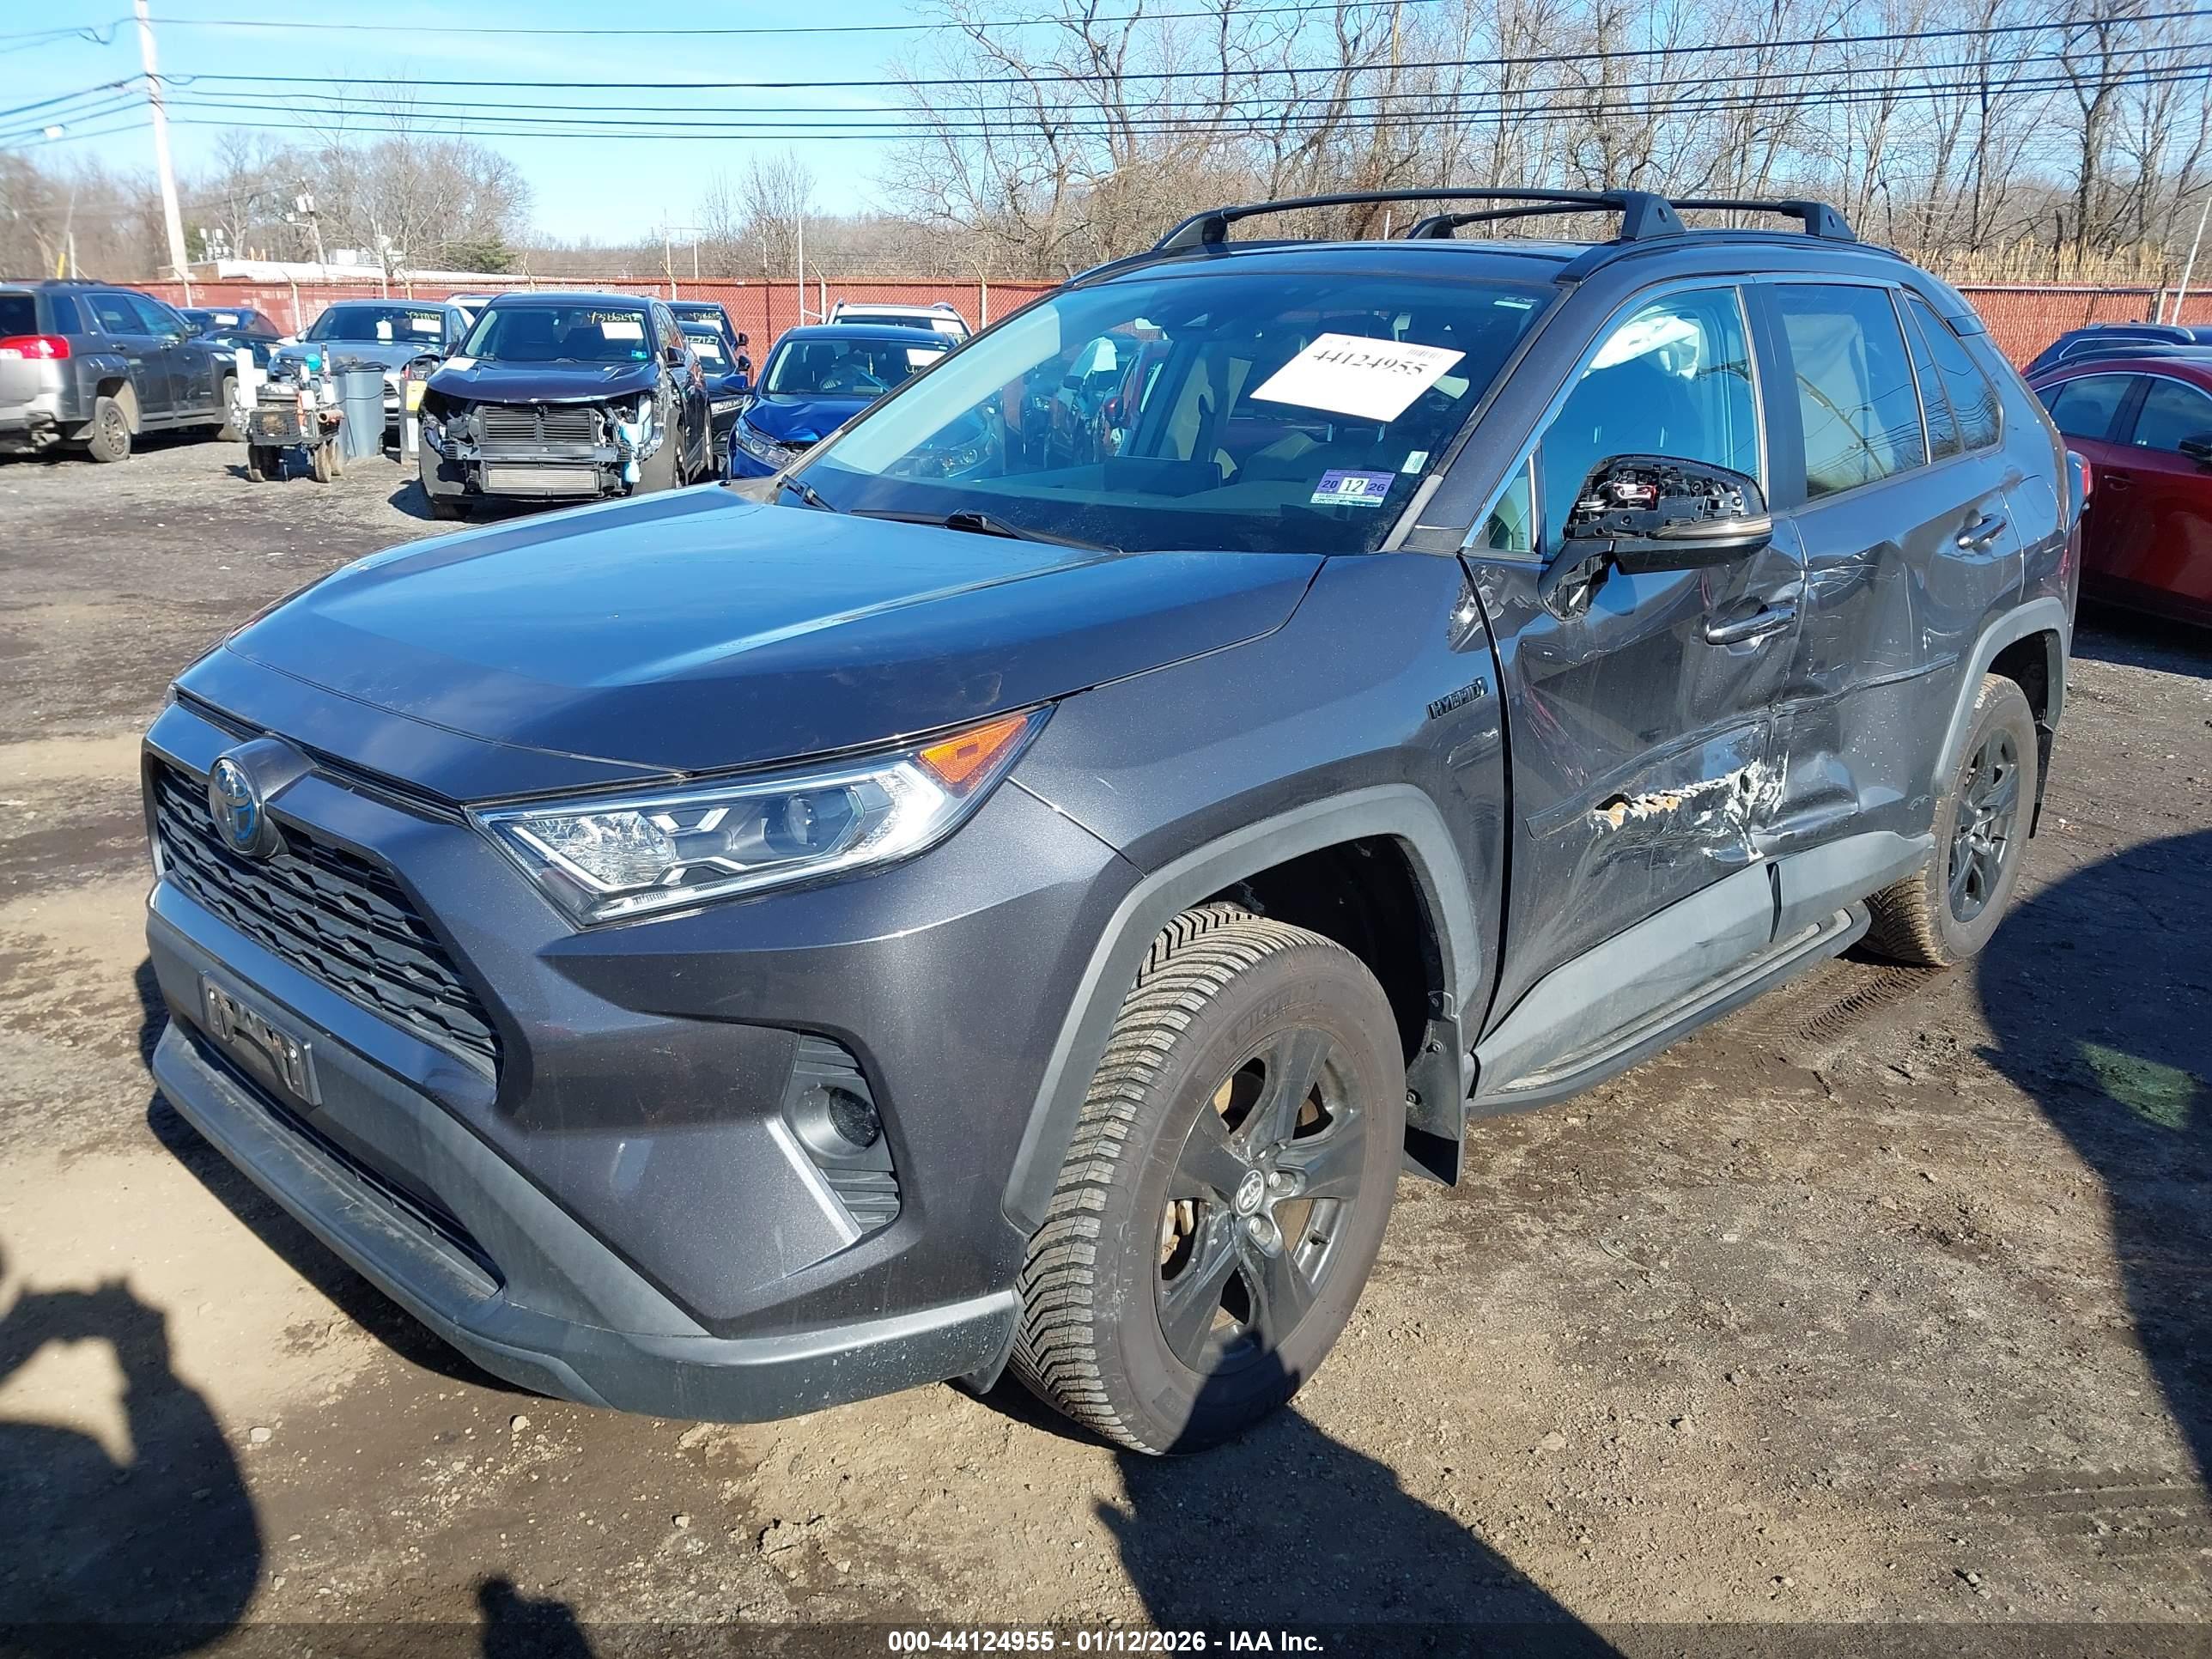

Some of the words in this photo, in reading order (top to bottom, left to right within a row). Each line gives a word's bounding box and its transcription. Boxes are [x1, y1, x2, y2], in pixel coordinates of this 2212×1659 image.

[1313, 350, 1429, 375] 44124955
[1322, 480, 1338, 489] 20
[1342, 479, 1364, 492] 12
[1368, 483, 1387, 492] 26
[1427, 679, 1486, 720] HYBRID
